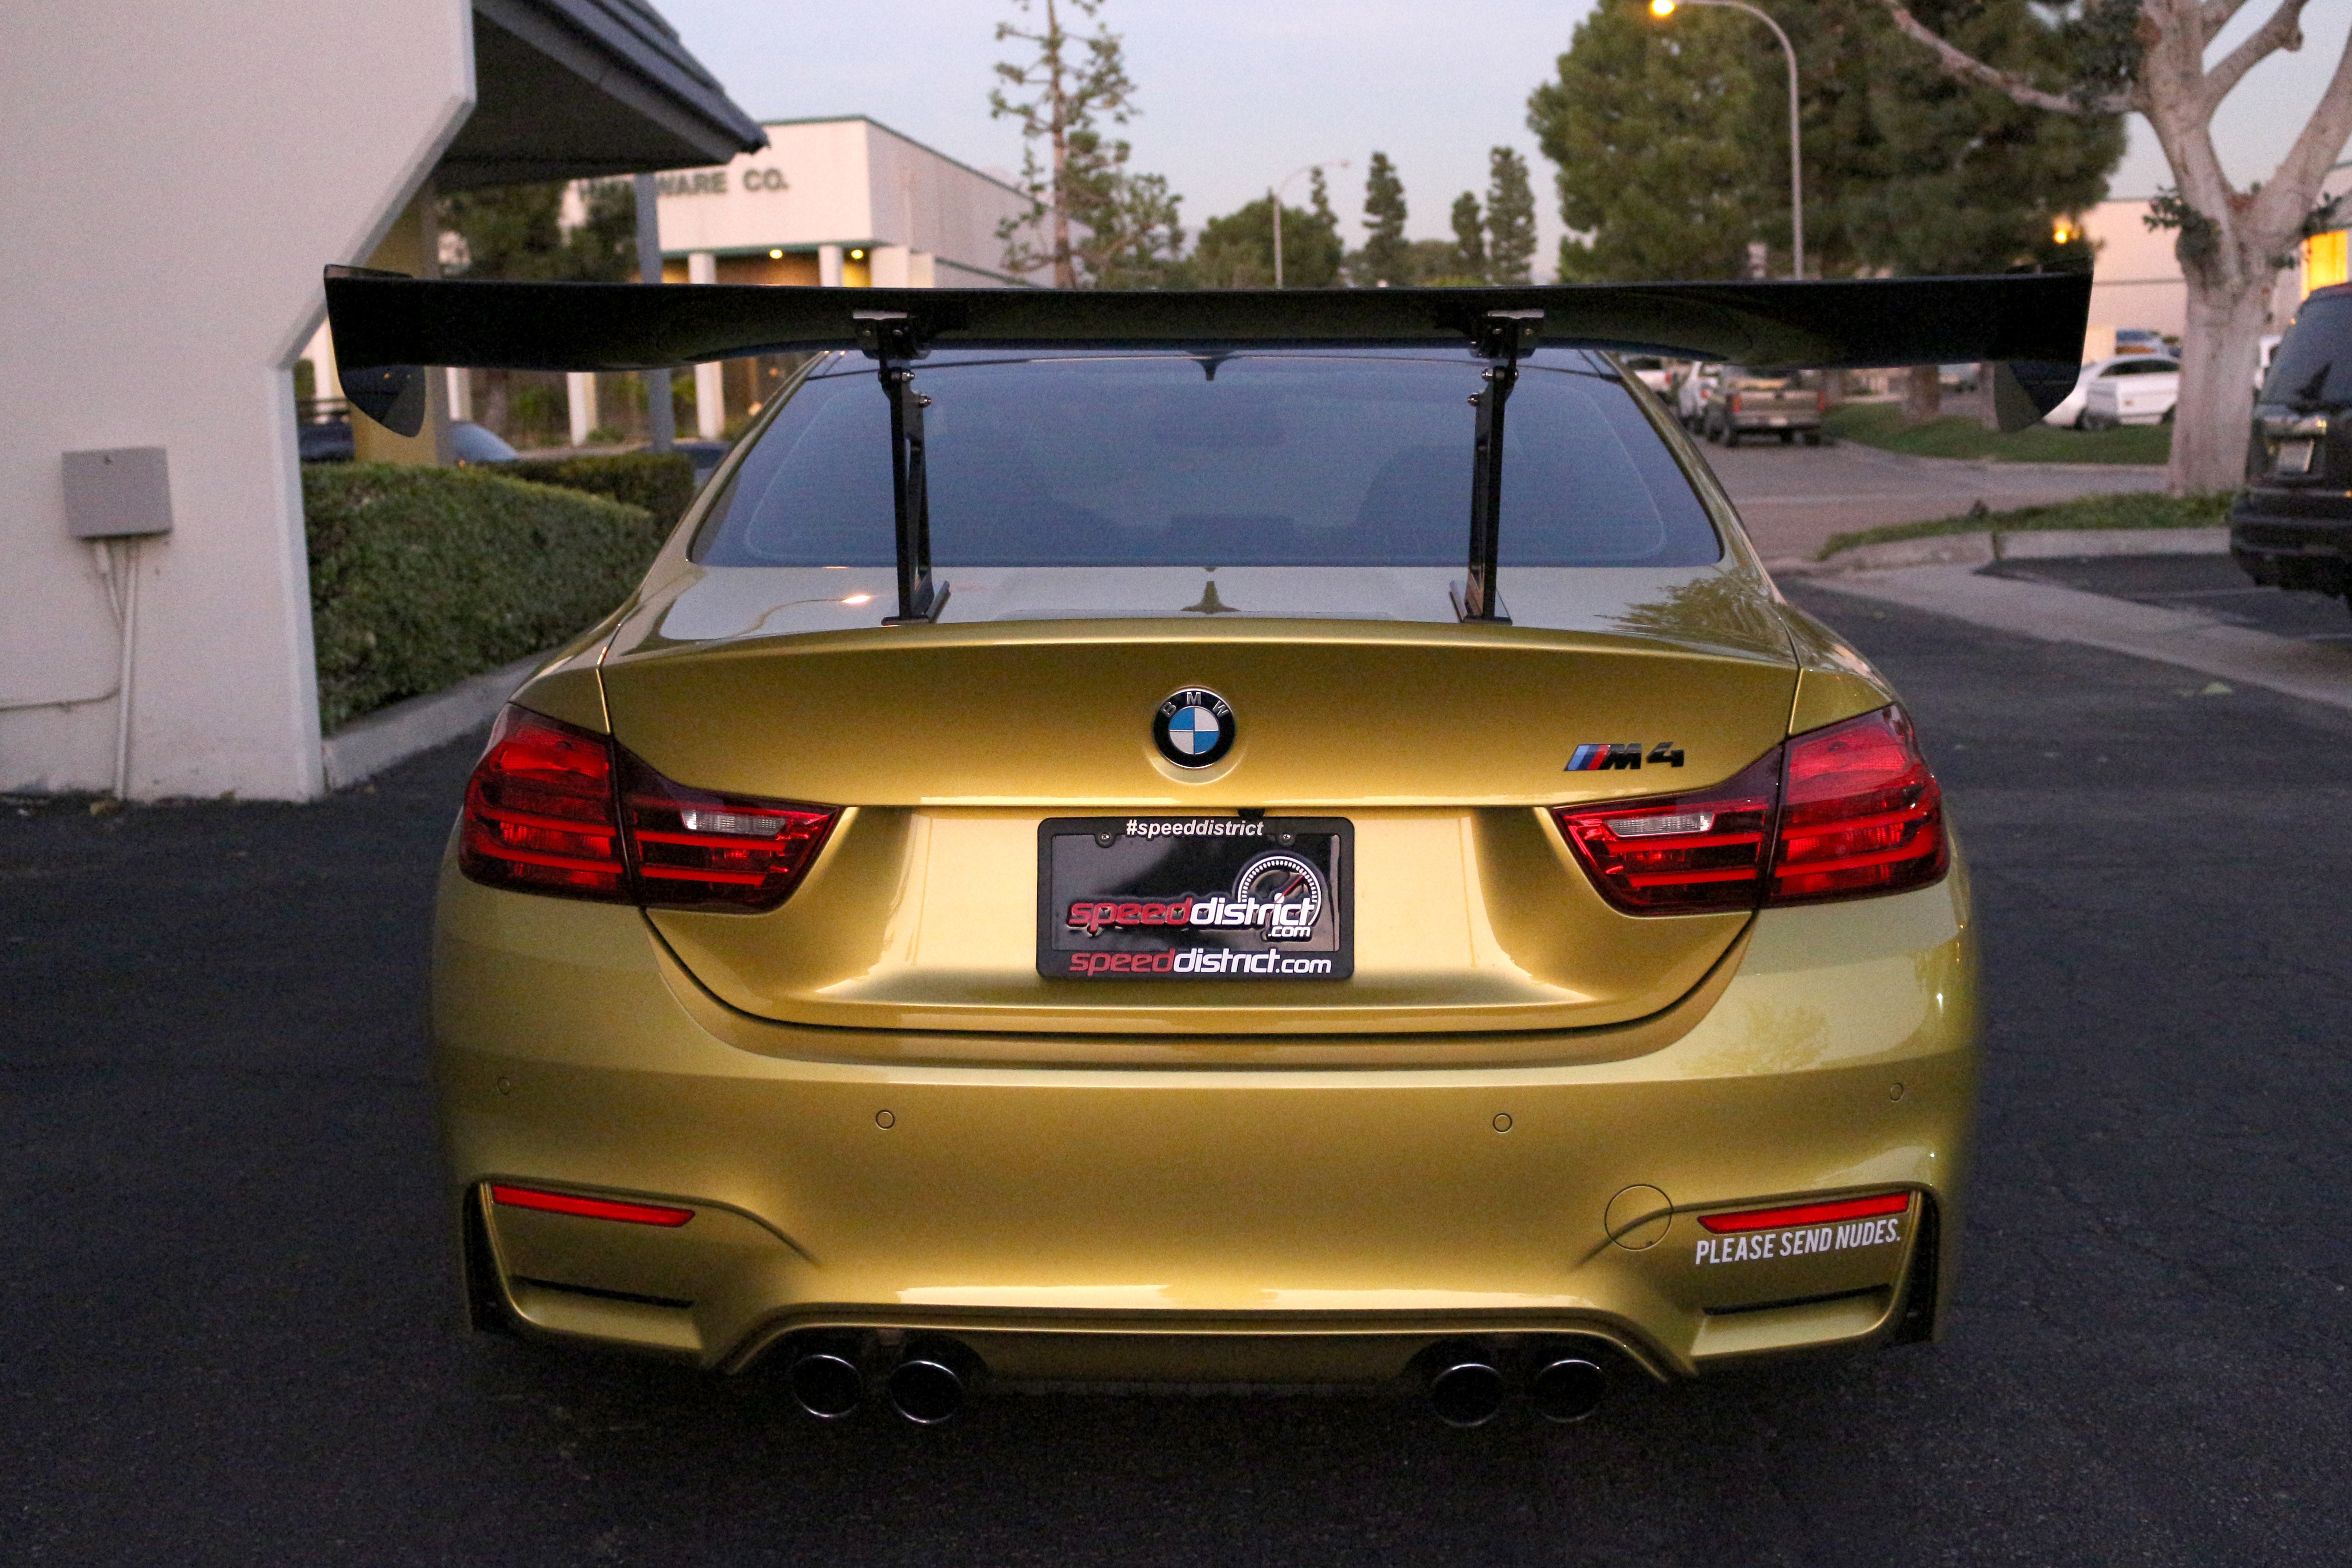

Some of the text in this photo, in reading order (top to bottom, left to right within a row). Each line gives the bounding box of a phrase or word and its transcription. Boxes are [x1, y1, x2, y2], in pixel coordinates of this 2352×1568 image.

[743, 169, 789, 191] CO.
[1160, 691, 1229, 718] BMW
[1597, 742, 1684, 770] M4
[1126, 820, 1263, 839] #speeddistrict
[1069, 897, 1315, 932] speeddistrict
[1070, 948, 1332, 976] speeddistrict.com
[1695, 1218, 1900, 1264] PLEASE SEND NUDES.
